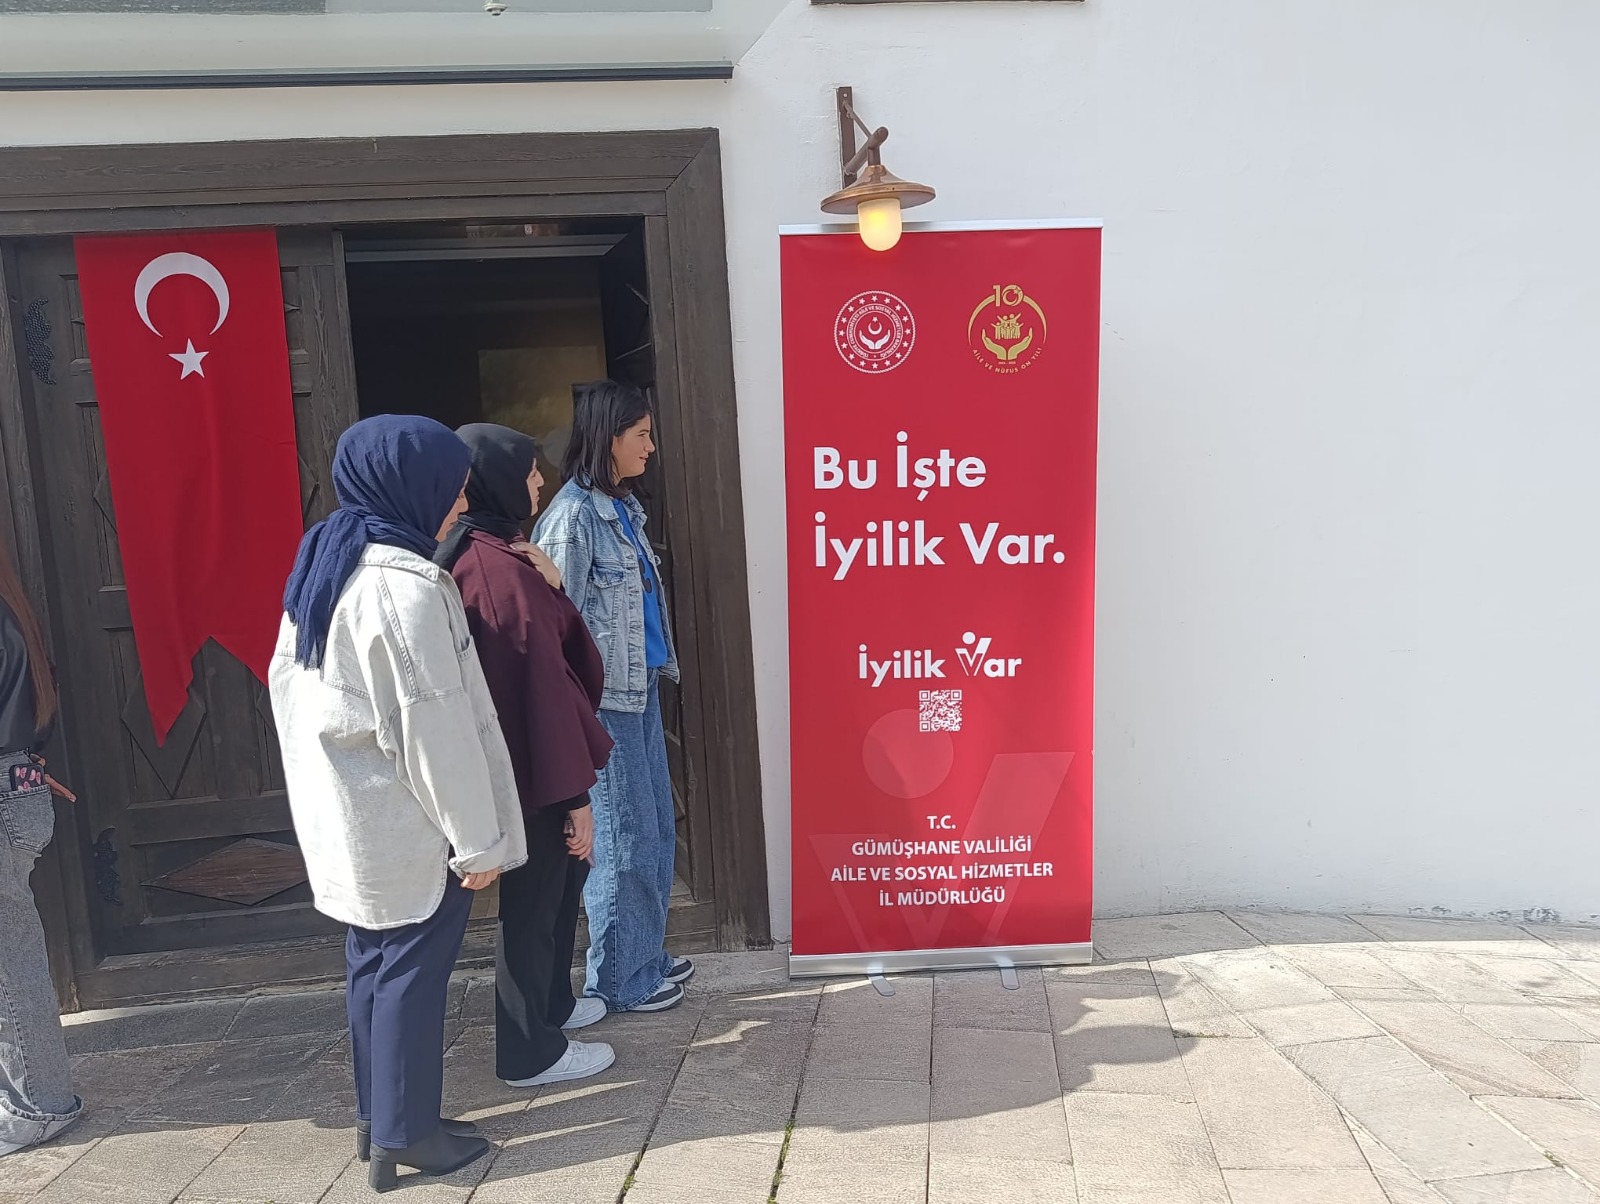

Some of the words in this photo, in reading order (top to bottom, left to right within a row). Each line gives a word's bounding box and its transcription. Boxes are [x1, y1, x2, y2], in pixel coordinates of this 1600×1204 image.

[985, 362, 993, 371] VE
[1021, 361, 1032, 370] ON
[813, 446, 877, 490] Bu
[896, 430, 987, 502] İşte
[814, 511, 946, 581] İyilik
[958, 522, 1066, 565] Var.
[859, 643, 947, 688] İyilik
[955, 631, 1022, 678] Var
[926, 815, 957, 830] T.C.
[851, 839, 961, 859] GÜMÜŞHANE
[963, 835, 1032, 854] VALİLİĞİ
[830, 864, 867, 882] AİLE
[869, 867, 891, 881] VE
[894, 865, 958, 881] SOSYAL
[961, 862, 1053, 880] HİZMETLER
[879, 889, 894, 906] İL
[897, 886, 1006, 906] MÜDÜRLÜĞÜ
